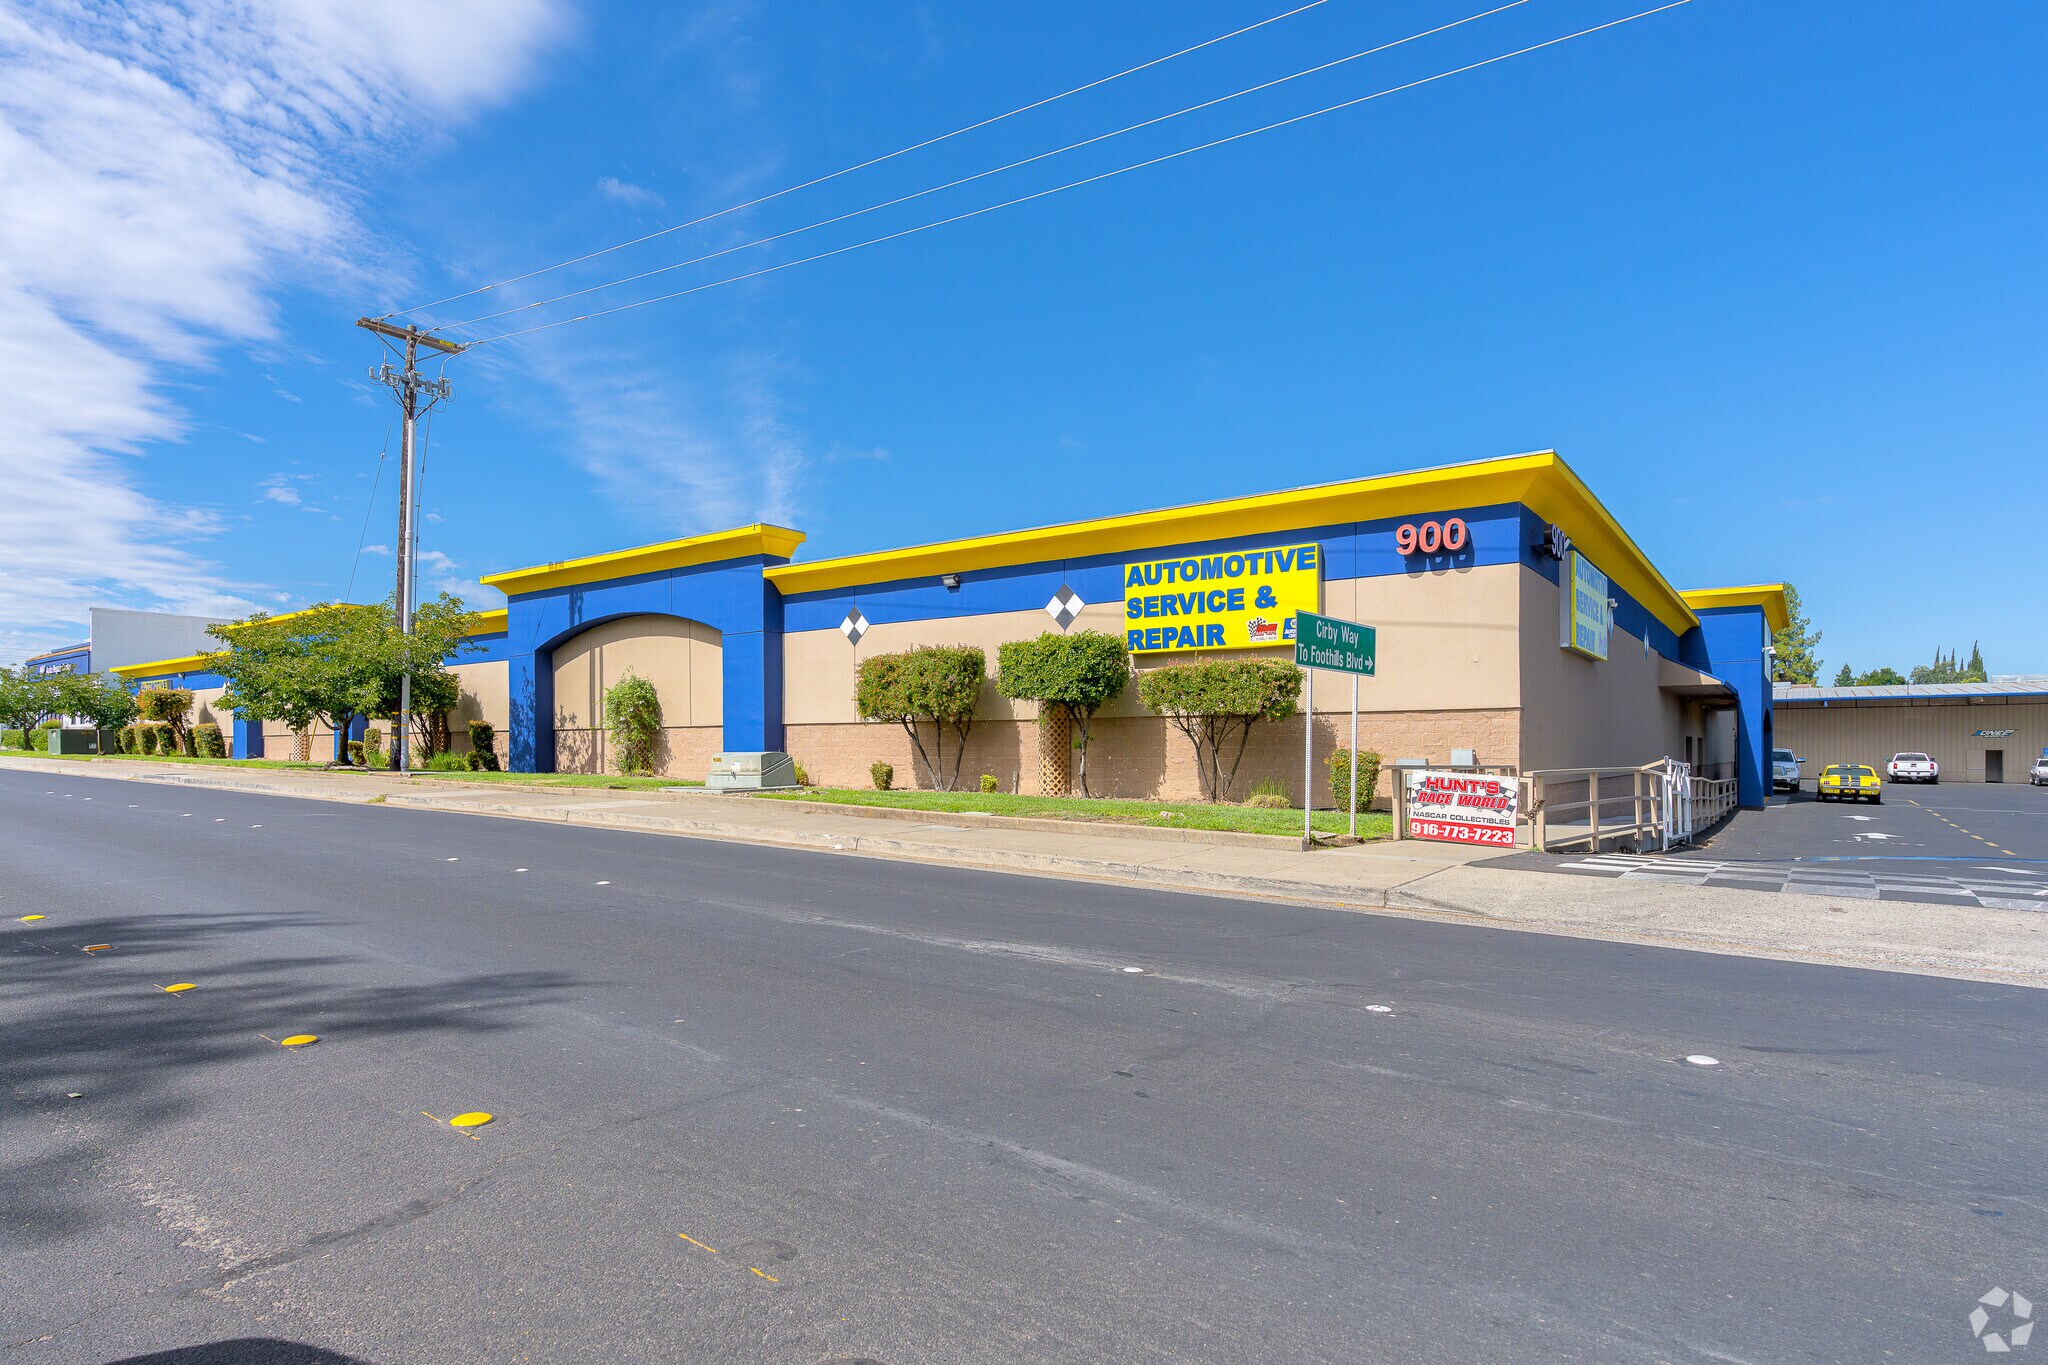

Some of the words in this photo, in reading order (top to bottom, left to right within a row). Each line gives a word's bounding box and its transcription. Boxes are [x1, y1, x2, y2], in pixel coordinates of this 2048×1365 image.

[1395, 517, 1467, 556] 900
[1551, 523, 1566, 561] 900
[1126, 546, 1317, 588] AUTOMOTIVE
[1126, 588, 1245, 619] SERVICE
[1254, 585, 1278, 609] &
[1575, 588, 1599, 622] SERVICE
[1128, 624, 1226, 651] REPAIR
[1316, 620, 1338, 645] Cirby
[1341, 625, 1359, 649] Way
[1575, 622, 1595, 653] REPAIR
[1298, 643, 1308, 662] To
[1310, 645, 1344, 667] Foothills
[1346, 651, 1363, 670] Blvd
[1425, 776, 1500, 795] HUNT'S
[1417, 791, 1454, 806] RACE
[1457, 793, 1510, 810] WORLD
[1410, 822, 1513, 844] 916-773-7223
[1413, 811, 1448, 820] NASCAR
[1449, 814, 1511, 826] COLLECTIBLES
